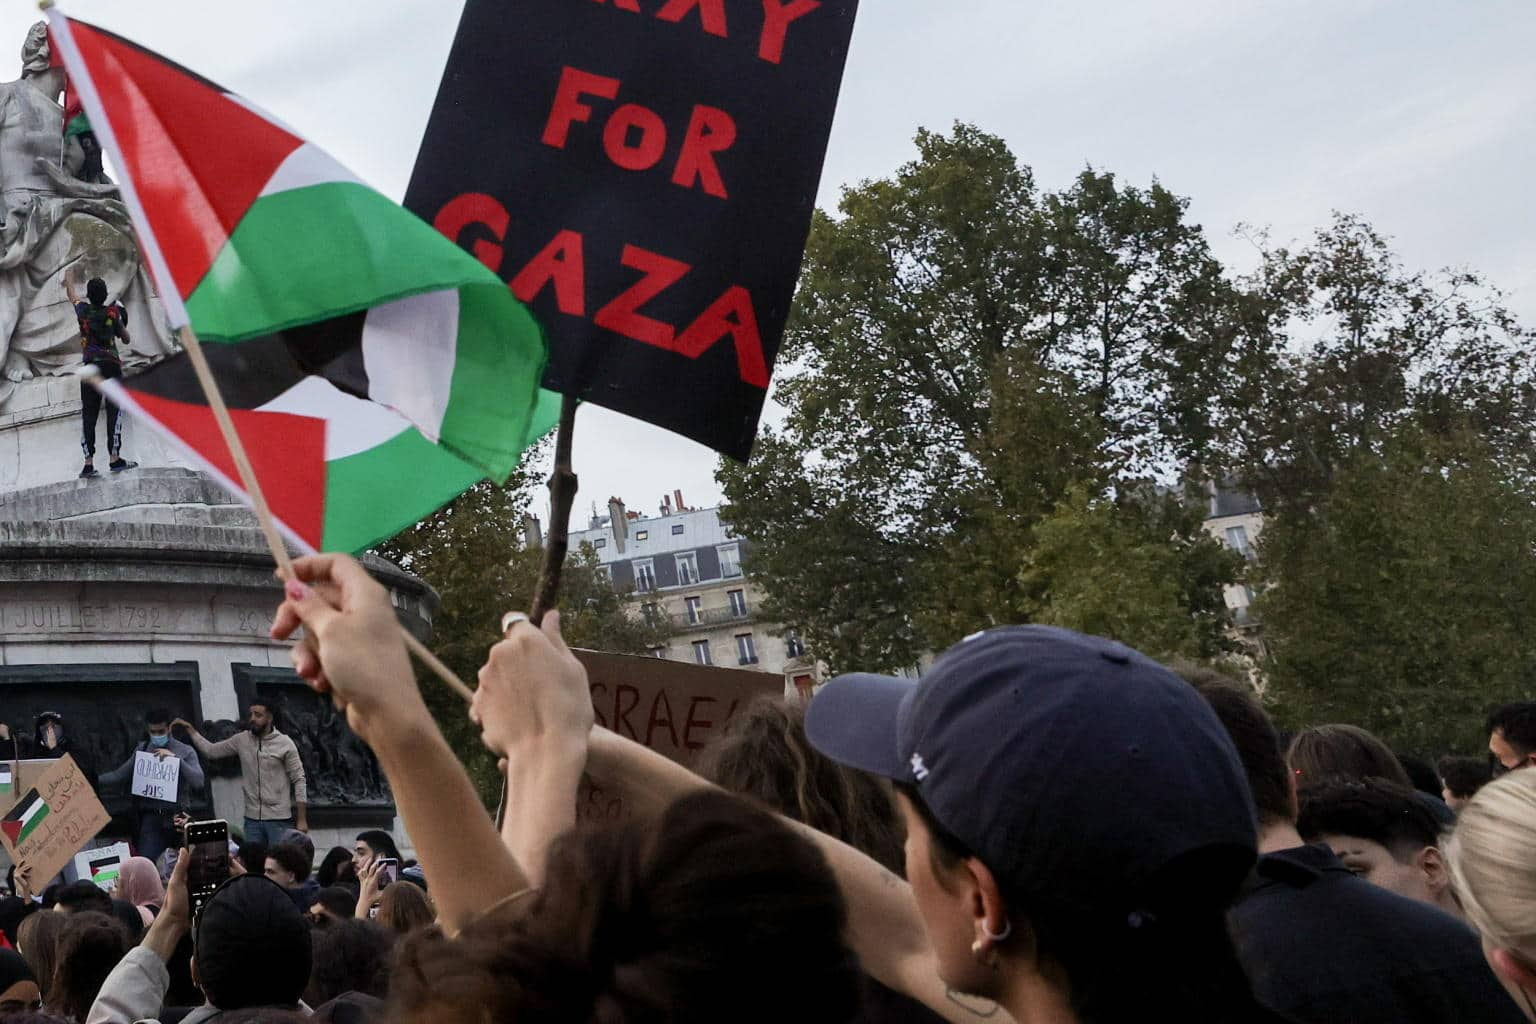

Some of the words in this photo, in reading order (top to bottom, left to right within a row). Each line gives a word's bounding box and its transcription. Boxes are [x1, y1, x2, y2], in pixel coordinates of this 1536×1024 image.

[433, 193, 771, 389] GAZA
[14, 605, 109, 629] JUILLET
[118, 606, 161, 629] 1792
[589, 682, 738, 749] SRAE
[142, 783, 164, 798] STOP
